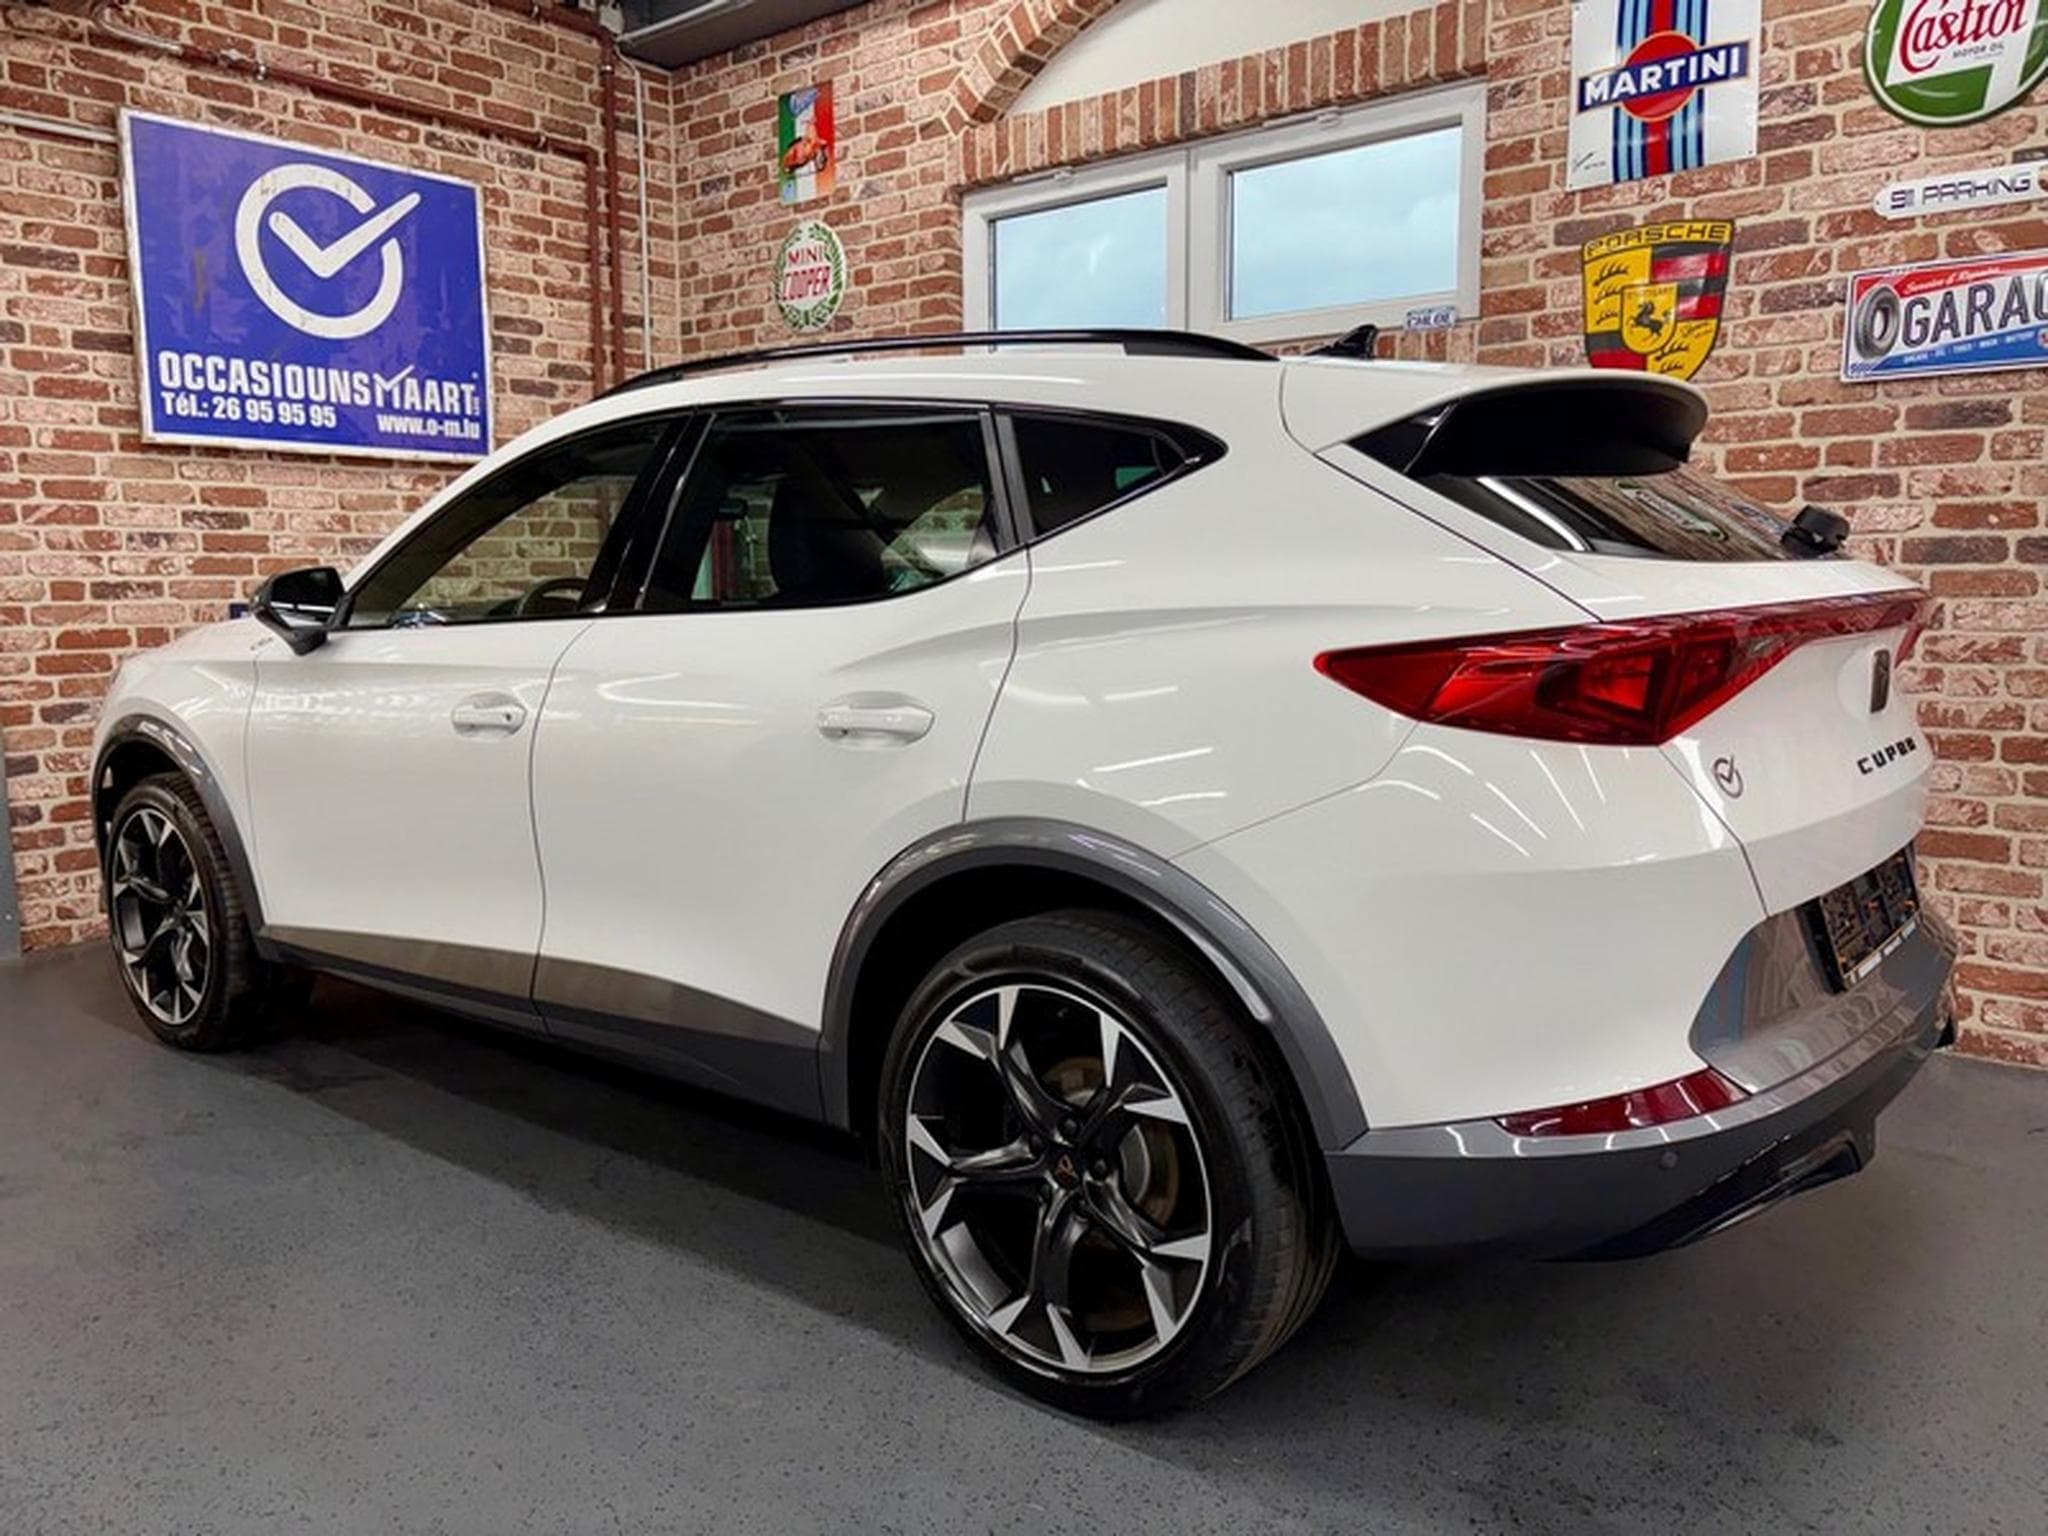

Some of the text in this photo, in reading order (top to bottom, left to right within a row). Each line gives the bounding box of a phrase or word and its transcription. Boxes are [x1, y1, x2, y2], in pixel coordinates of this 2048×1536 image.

[1899, 0, 2027, 73] Castrol
[1584, 47, 1740, 106] MARTINI
[1922, 171, 2031, 205] PARKING
[787, 246, 823, 265] MINI
[1586, 224, 1727, 257] PORSCHE
[782, 265, 832, 301] COOPER
[158, 351, 476, 416] OCCASIOUNSMAART
[213, 395, 241, 421] 26
[245, 399, 274, 423] 95
[278, 401, 306, 426] 95
[309, 404, 336, 428] 95
[377, 413, 480, 440] www.o-m.lu
